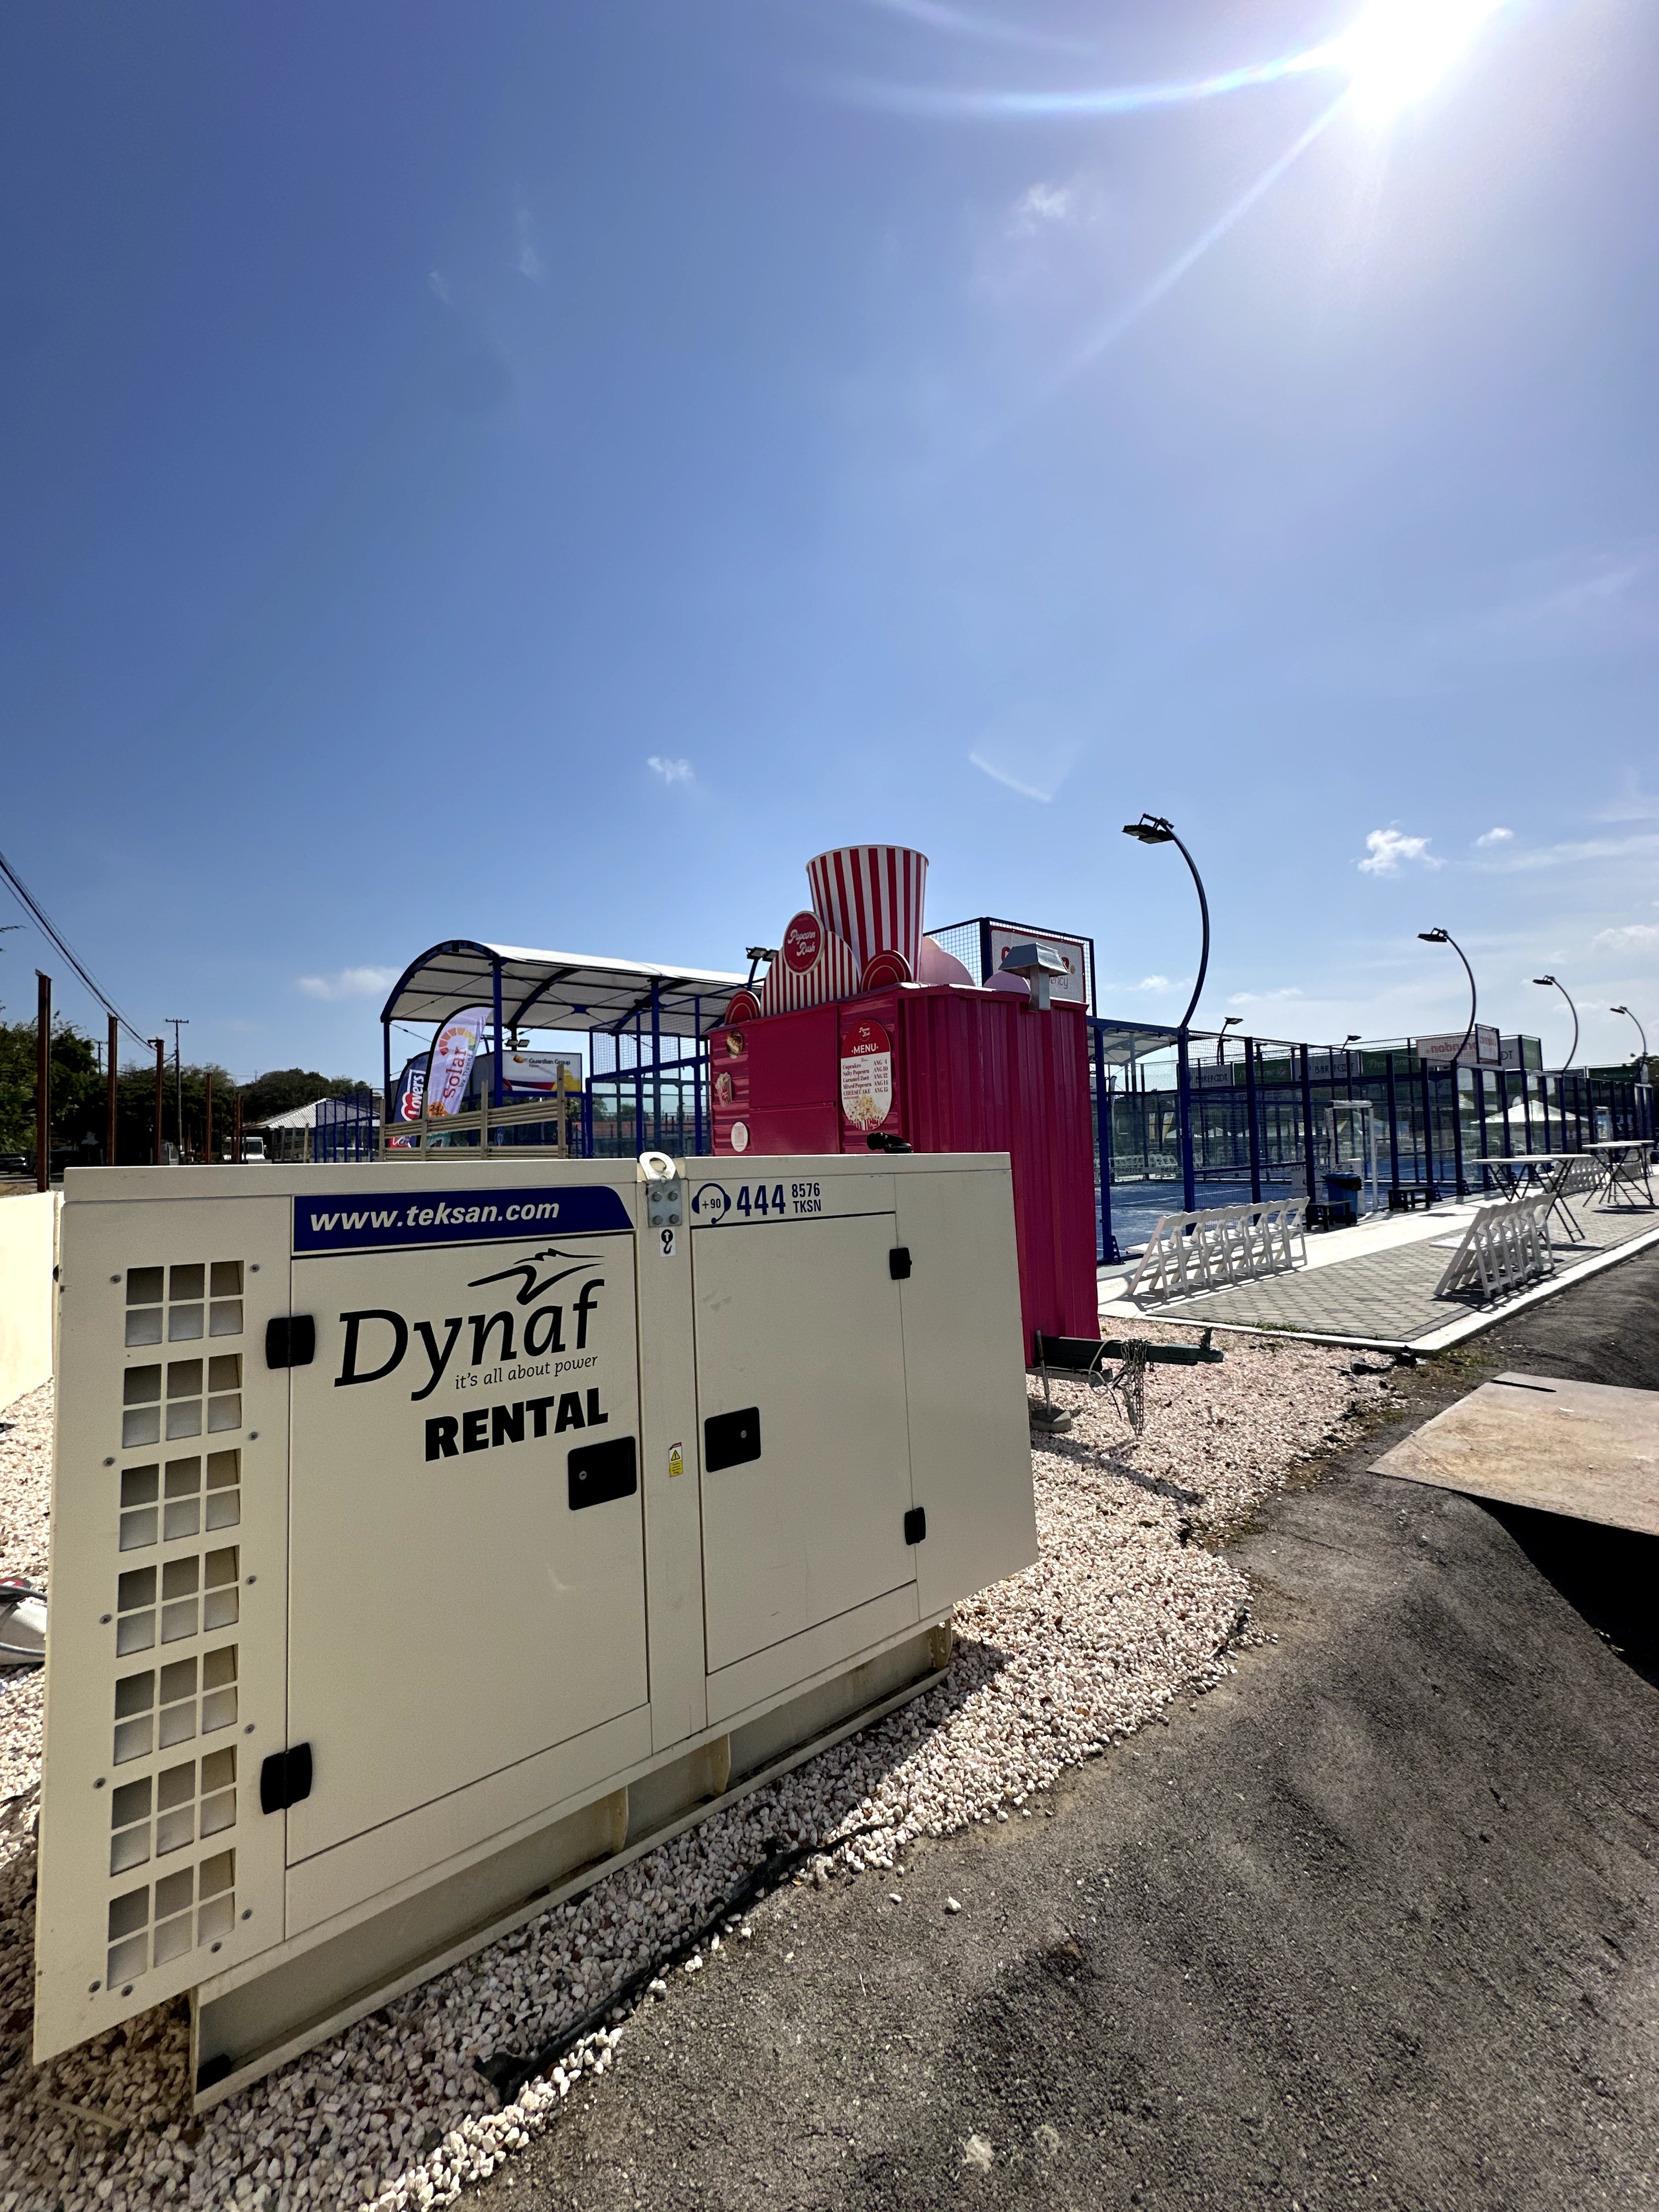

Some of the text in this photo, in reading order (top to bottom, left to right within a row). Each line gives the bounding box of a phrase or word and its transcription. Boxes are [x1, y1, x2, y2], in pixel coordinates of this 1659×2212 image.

[787, 929, 816, 944] Popcorn
[796, 941, 816, 957] Rush
[408, 1075, 425, 1116] Lovers
[702, 1182, 820, 1217] +90 444 8576
[793, 1199, 821, 1214] TKSN
[311, 1203, 560, 1232] www.teksan.com
[334, 1279, 605, 1401] Dynaf
[483, 1367, 503, 1385] all
[508, 1362, 550, 1381] about
[554, 1356, 599, 1377] power
[425, 1387, 608, 1462] RENTAL
